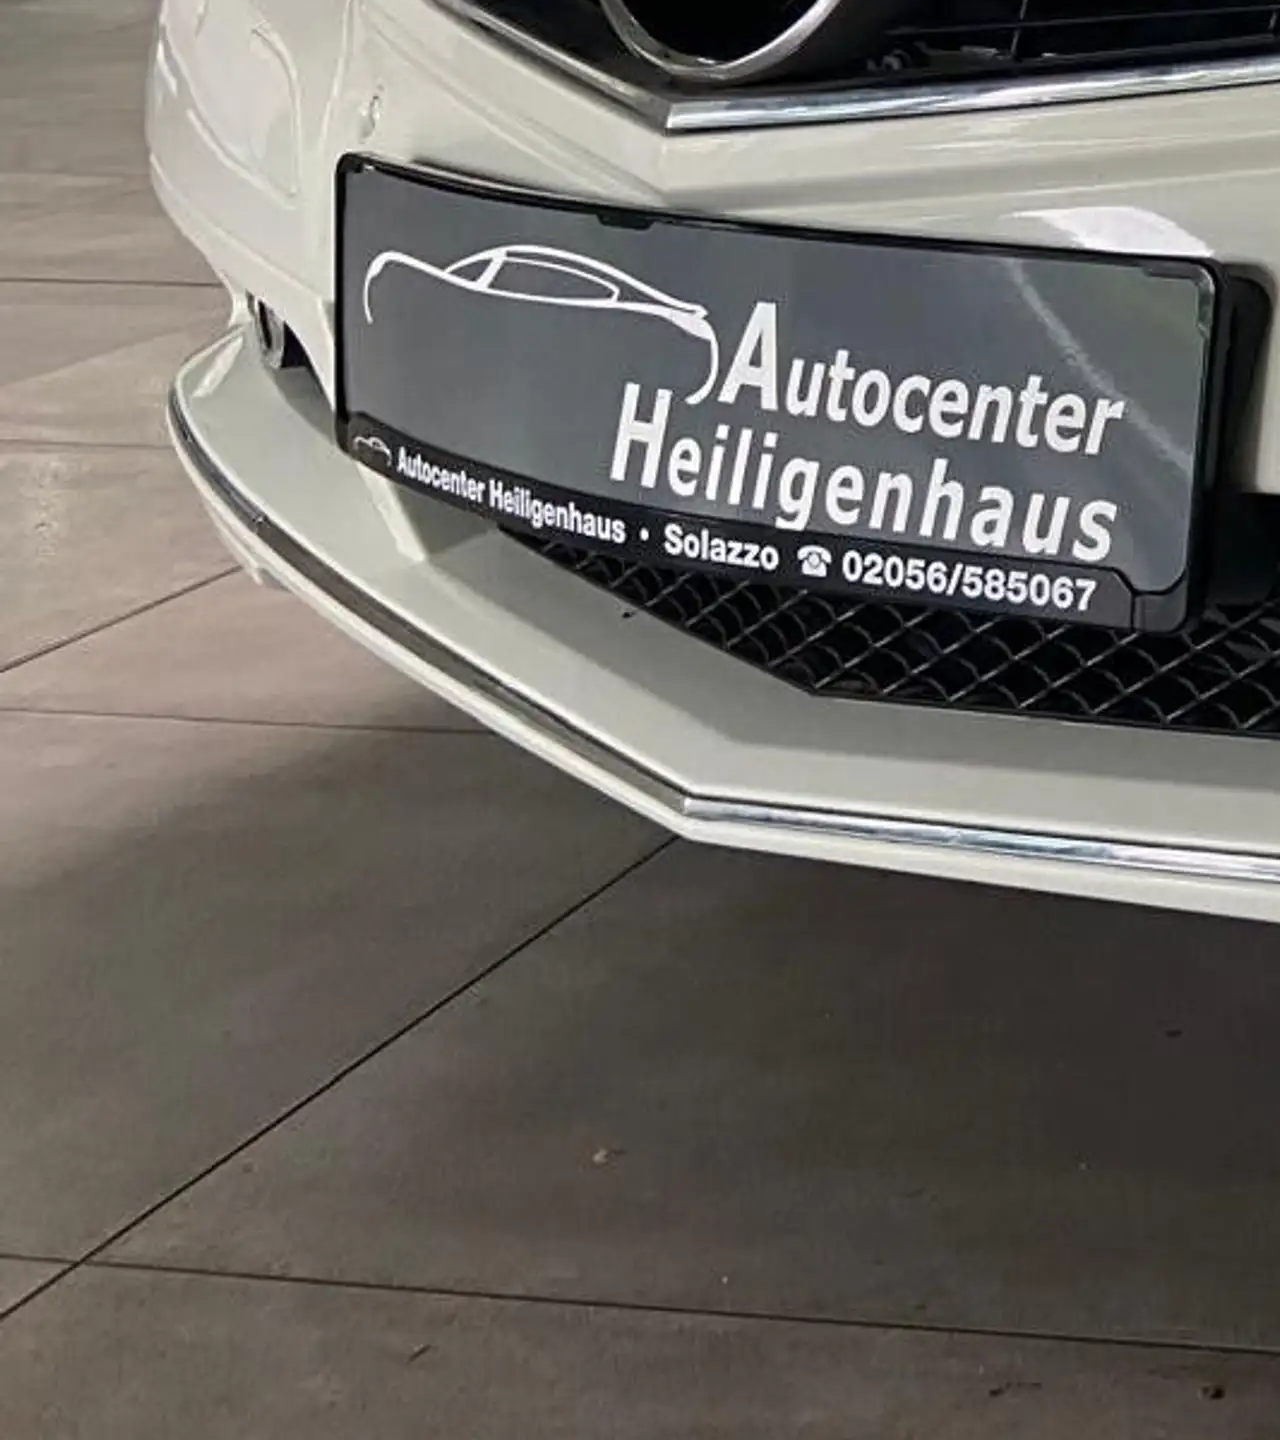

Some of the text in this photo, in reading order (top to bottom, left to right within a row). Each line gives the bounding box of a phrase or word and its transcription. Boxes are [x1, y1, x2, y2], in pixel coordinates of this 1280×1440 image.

[717, 301, 1125, 456] Autocenter
[397, 446, 1097, 611] Autocenter Heiligenhaus Solazzo 02056/585067
[609, 382, 1118, 562] Heiligenhaus
